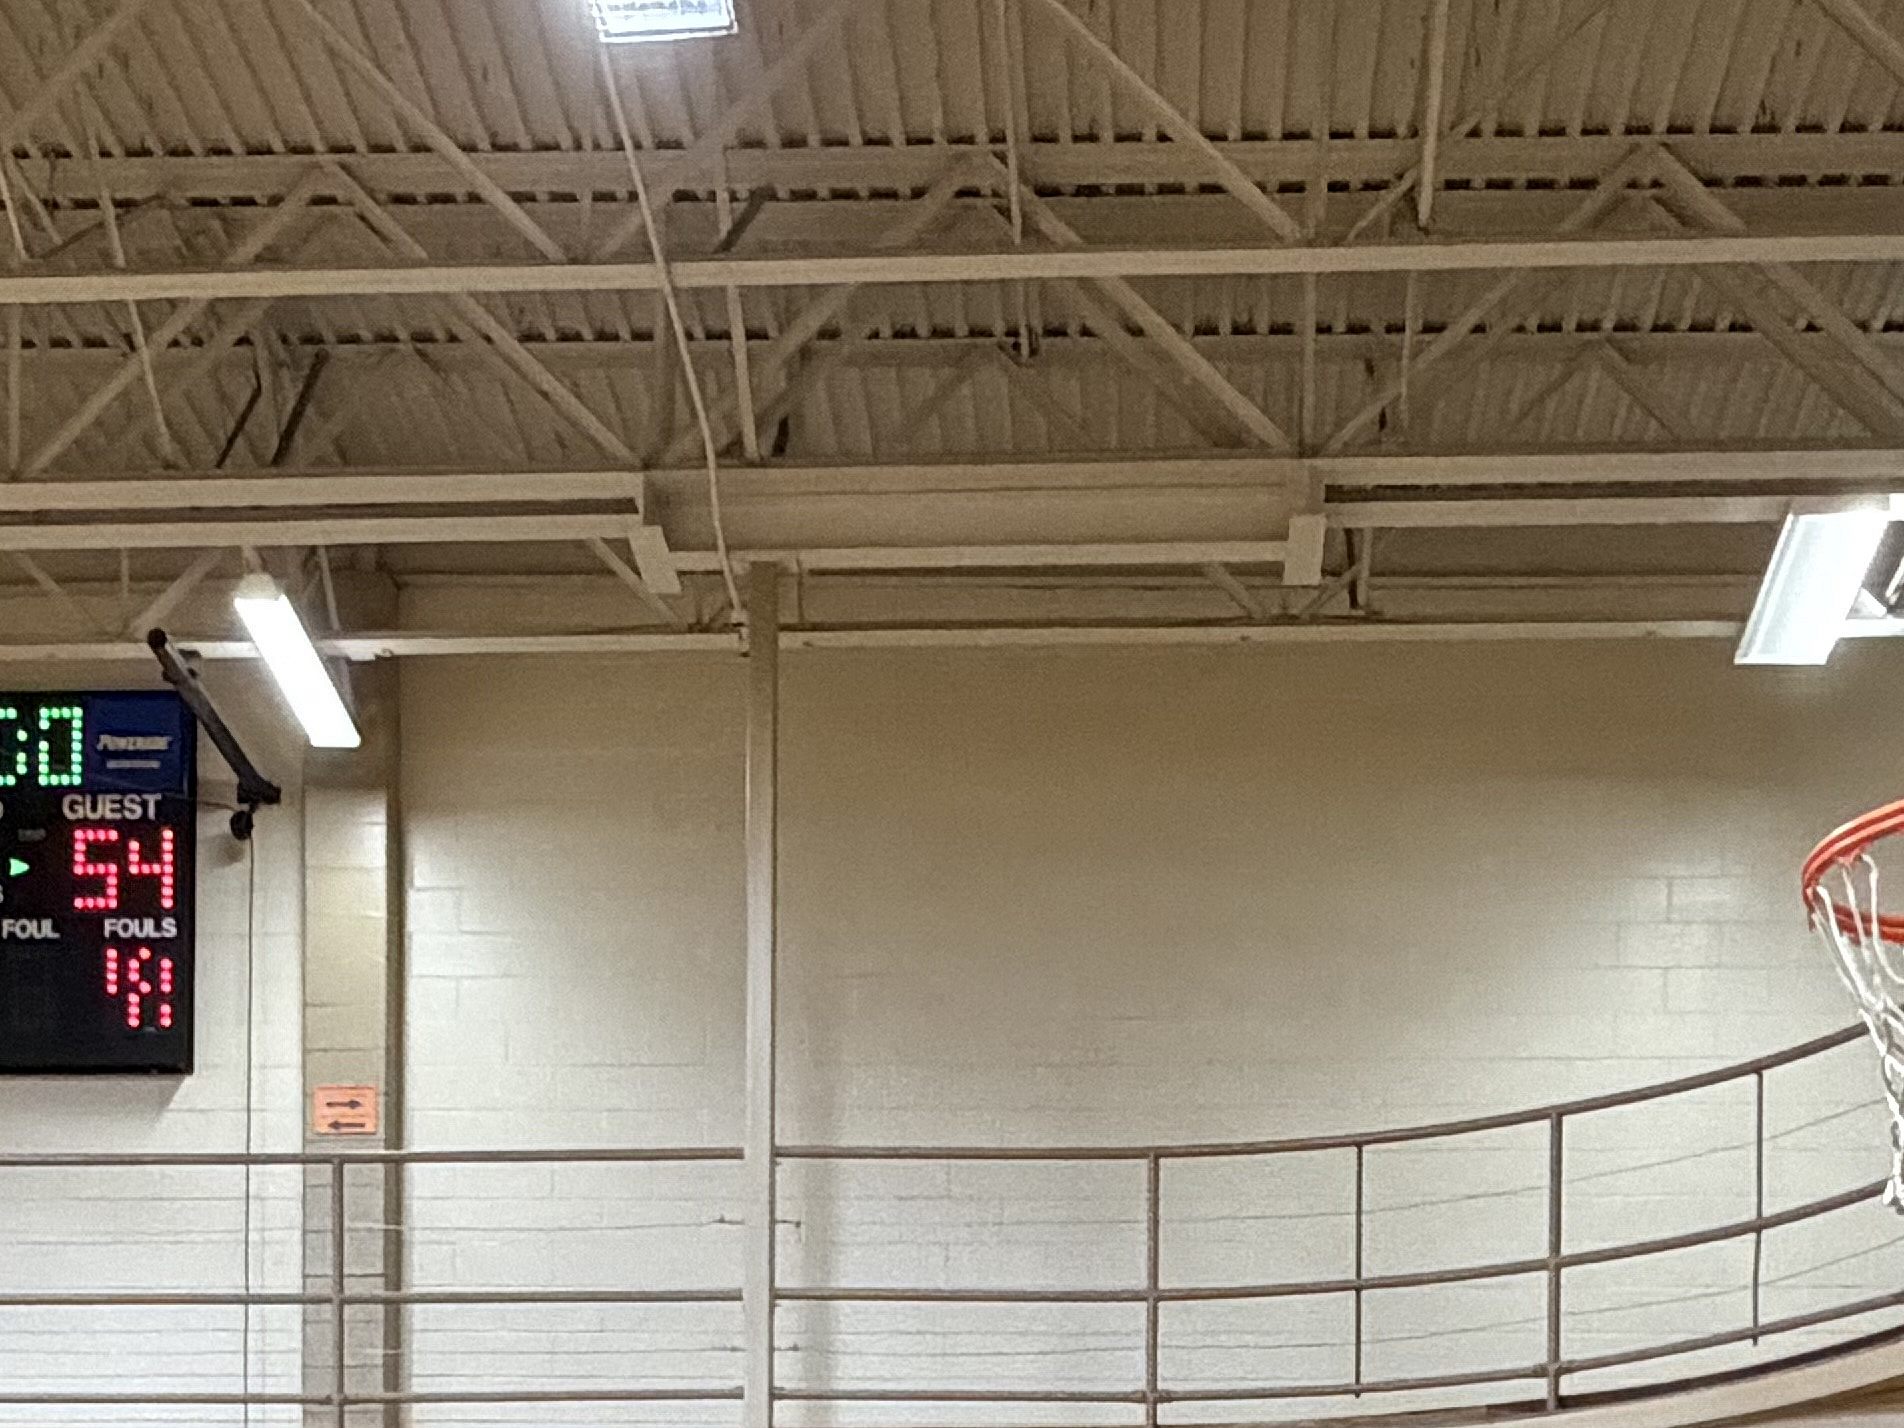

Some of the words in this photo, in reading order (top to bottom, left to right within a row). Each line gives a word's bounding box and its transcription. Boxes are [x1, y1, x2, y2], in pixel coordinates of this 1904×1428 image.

[62, 793, 162, 821] GUEST
[72, 827, 174, 910] 54
[1, 917, 61, 940] FOUL
[103, 917, 178, 939] FOULS
